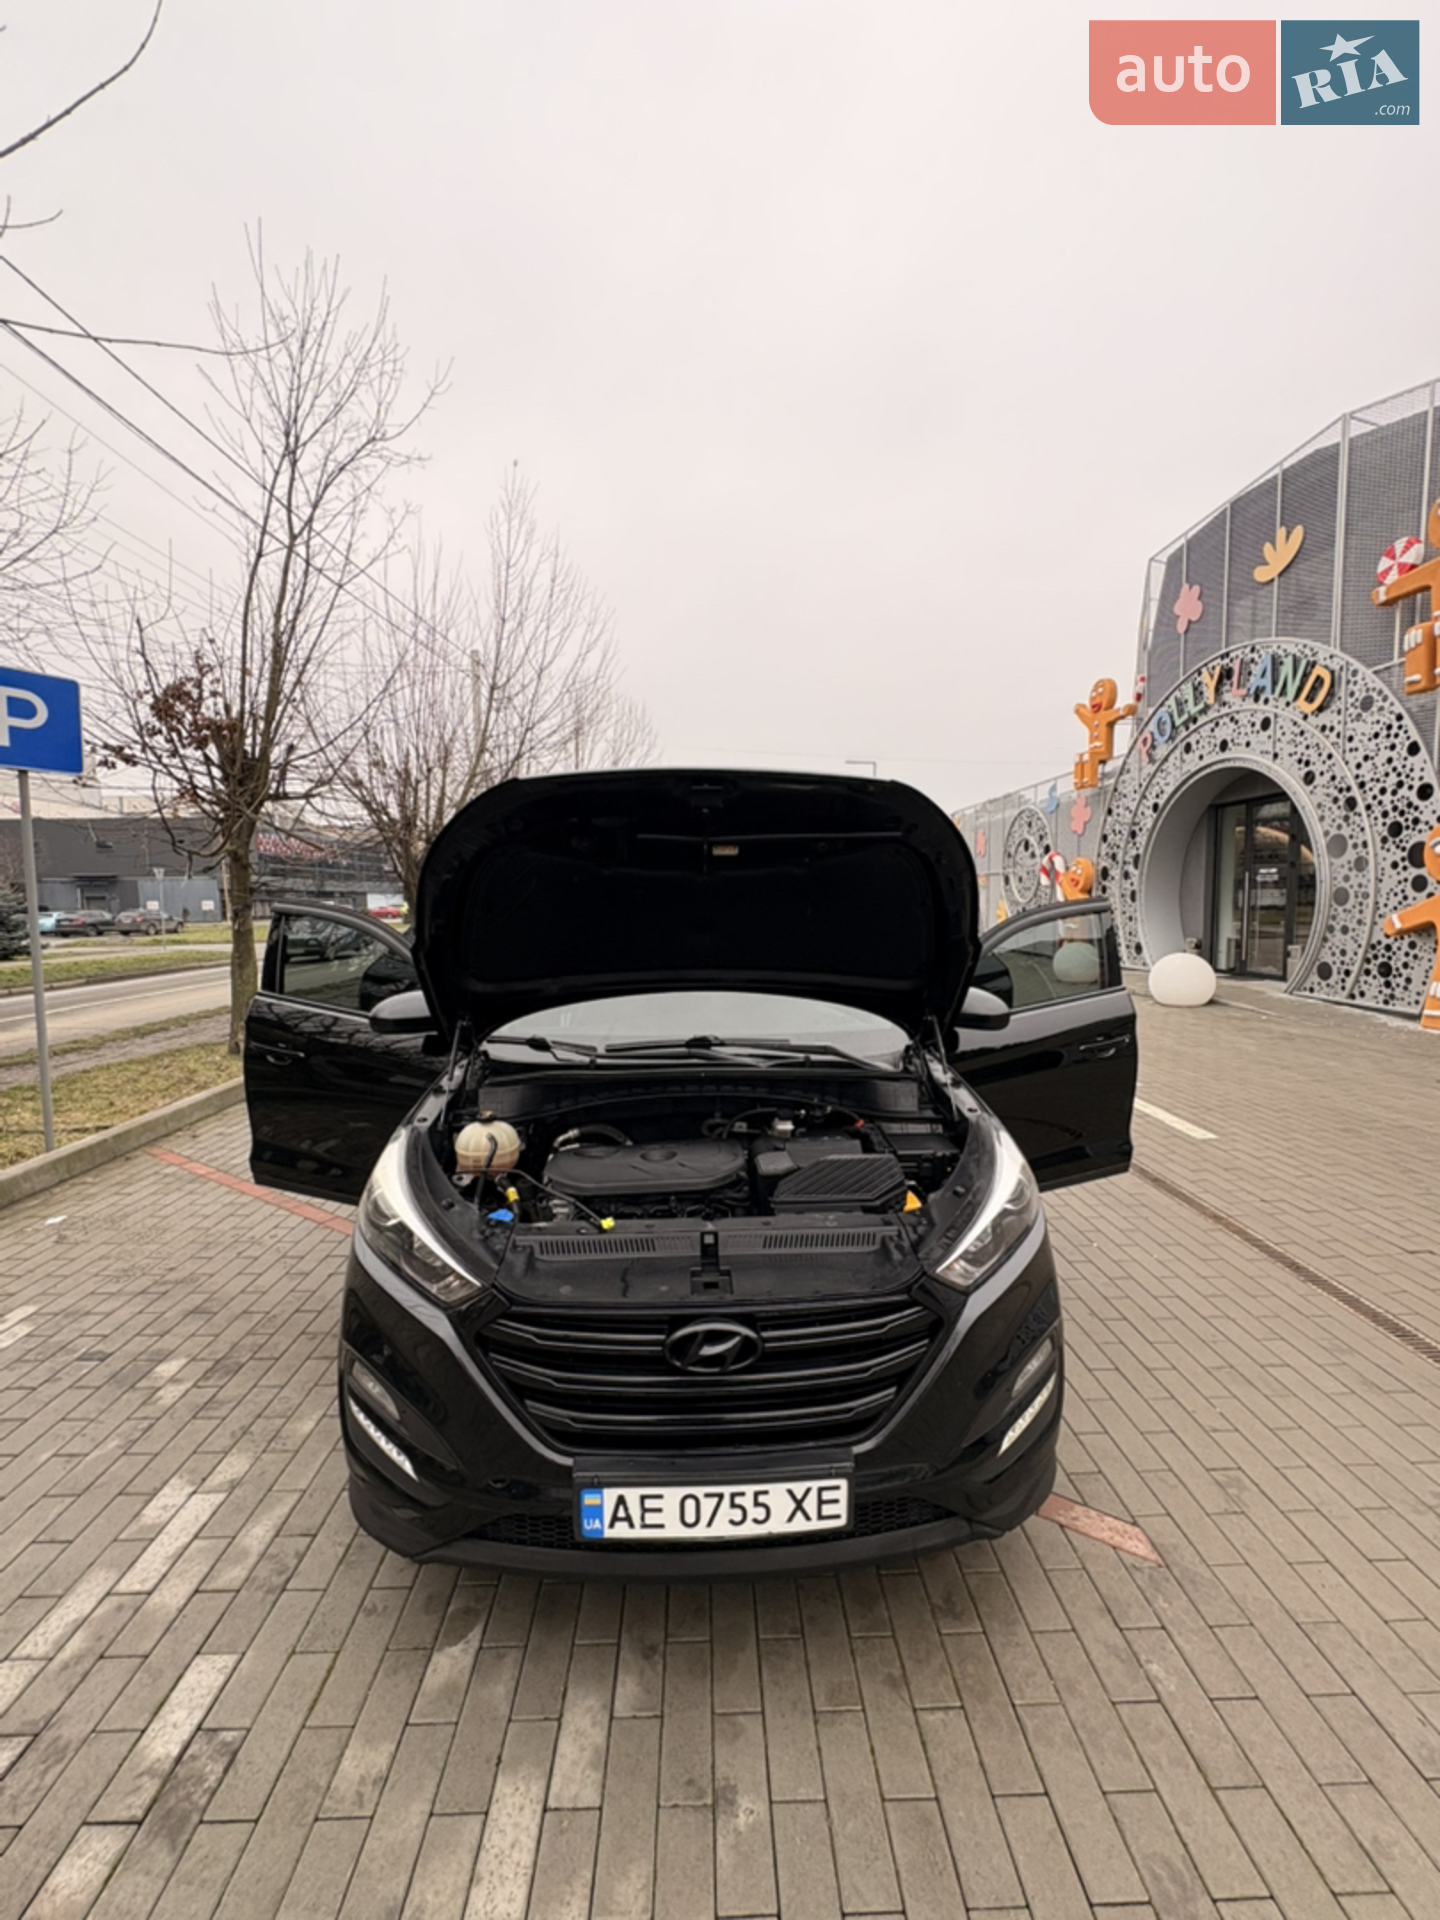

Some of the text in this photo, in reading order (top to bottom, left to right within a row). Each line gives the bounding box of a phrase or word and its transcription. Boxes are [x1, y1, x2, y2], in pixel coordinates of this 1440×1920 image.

[0, 686, 49, 747] P
[584, 1519, 602, 1530] UA
[607, 1485, 842, 1530] AE 0755 XE
